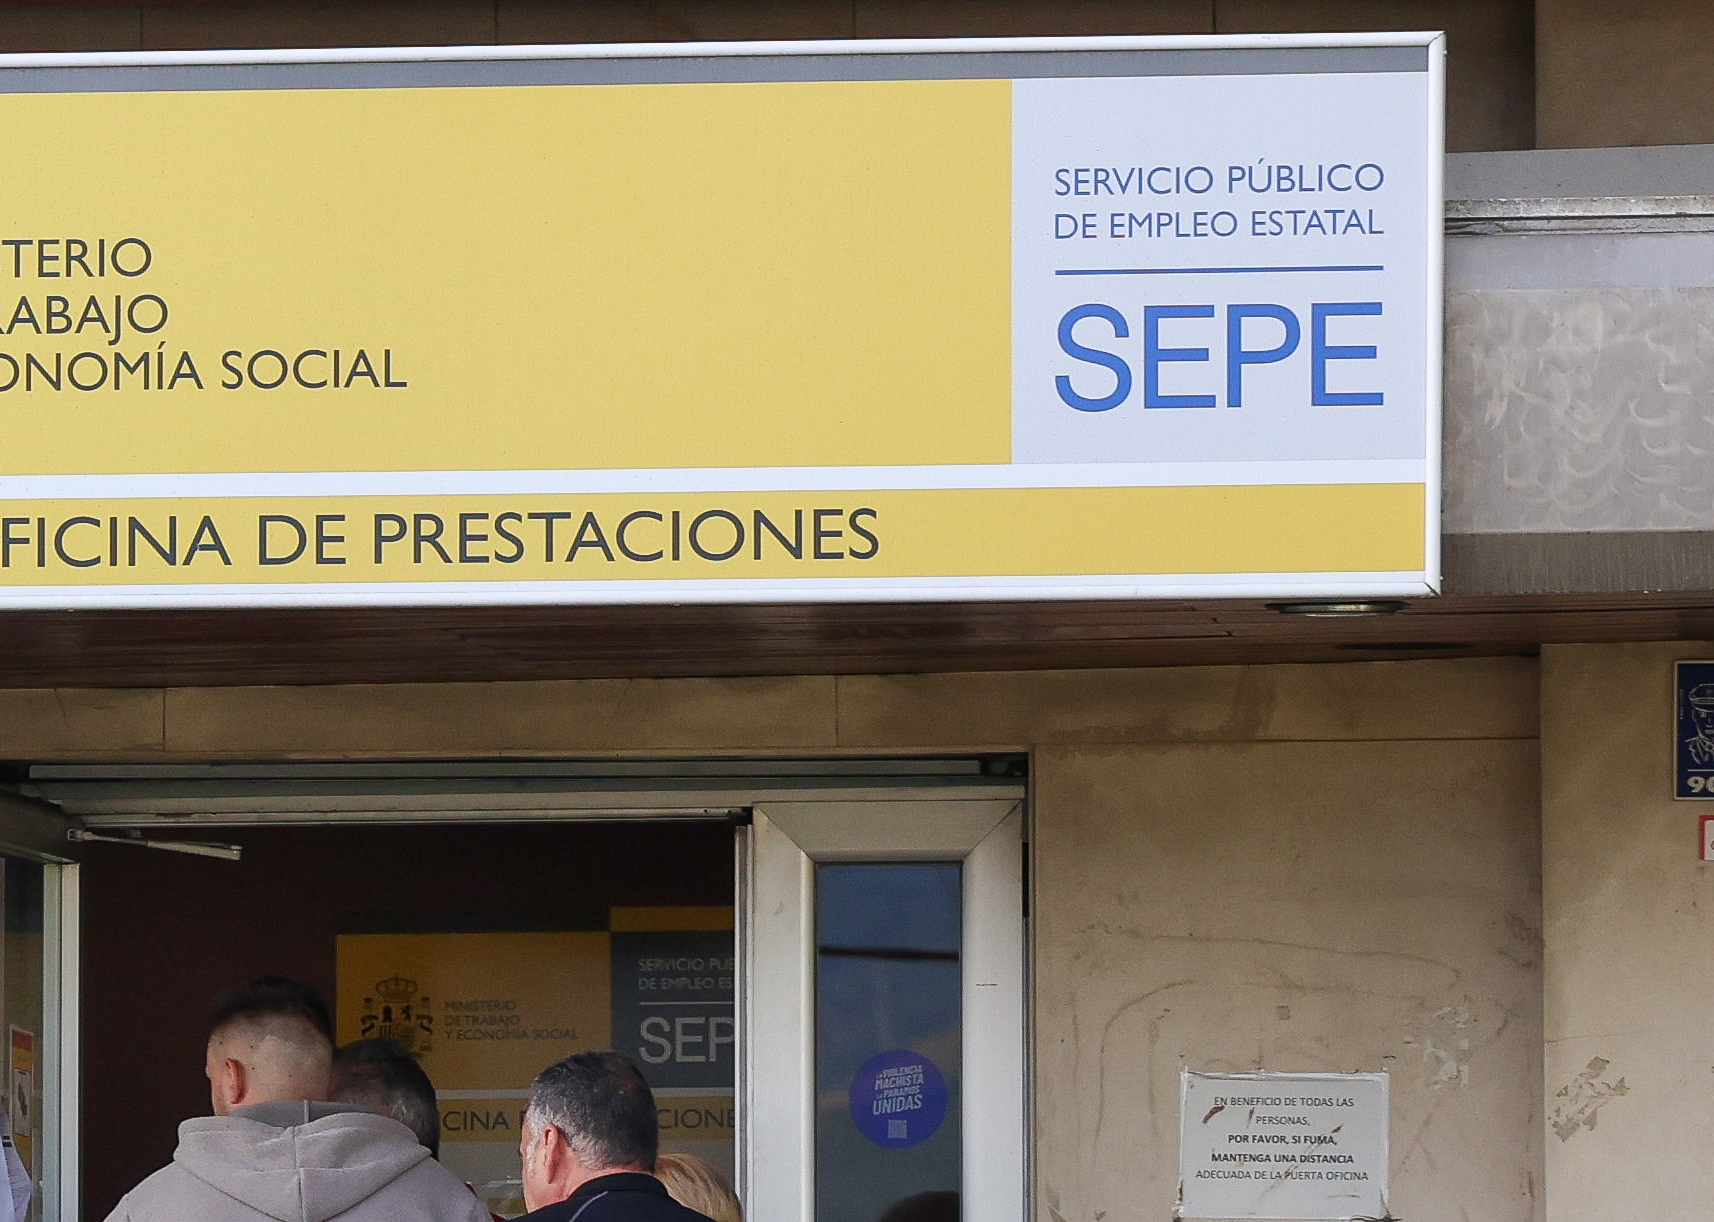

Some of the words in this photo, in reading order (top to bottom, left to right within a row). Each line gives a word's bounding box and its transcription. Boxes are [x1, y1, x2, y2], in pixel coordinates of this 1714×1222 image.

[1054, 166, 1214, 197] SERVICIO
[1228, 158, 1385, 194] PÚBLICO
[1054, 213, 1098, 240] DE
[1110, 210, 1238, 239] EMPLEO
[1251, 208, 1385, 237] ESTATAL
[1054, 301, 1385, 413] SEPE
[221, 348, 408, 390] SOCIAL
[258, 514, 347, 566] DE
[374, 507, 879, 565] PRESTACIONES
[638, 977, 657, 990] DE
[661, 976, 715, 990] EMPLEO
[638, 1016, 734, 1064] SEP
[872, 1094, 923, 1115] UNIDAS
[1214, 1096, 1227, 1106] EN
[1230, 1096, 1282, 1106] BENEFICIO
[1284, 1097, 1297, 1107] DE
[1299, 1097, 1334, 1107] TODAS
[1336, 1097, 1354, 1107] LAS
[442, 1110, 510, 1132] CINA
[1228, 1134, 1250, 1144] POR
[1291, 1134, 1301, 1145] SI
[1211, 1153, 1271, 1163] MANTENGA
[1274, 1154, 1297, 1163] UNA
[1299, 1154, 1354, 1164] DISTANCIA
[1195, 1170, 1252, 1180] ADECUADA
[1254, 1171, 1267, 1180] DE
[1270, 1171, 1282, 1180] LA
[1284, 1171, 1323, 1180] PUERTA
[1326, 1171, 1369, 1181] OFICINA
